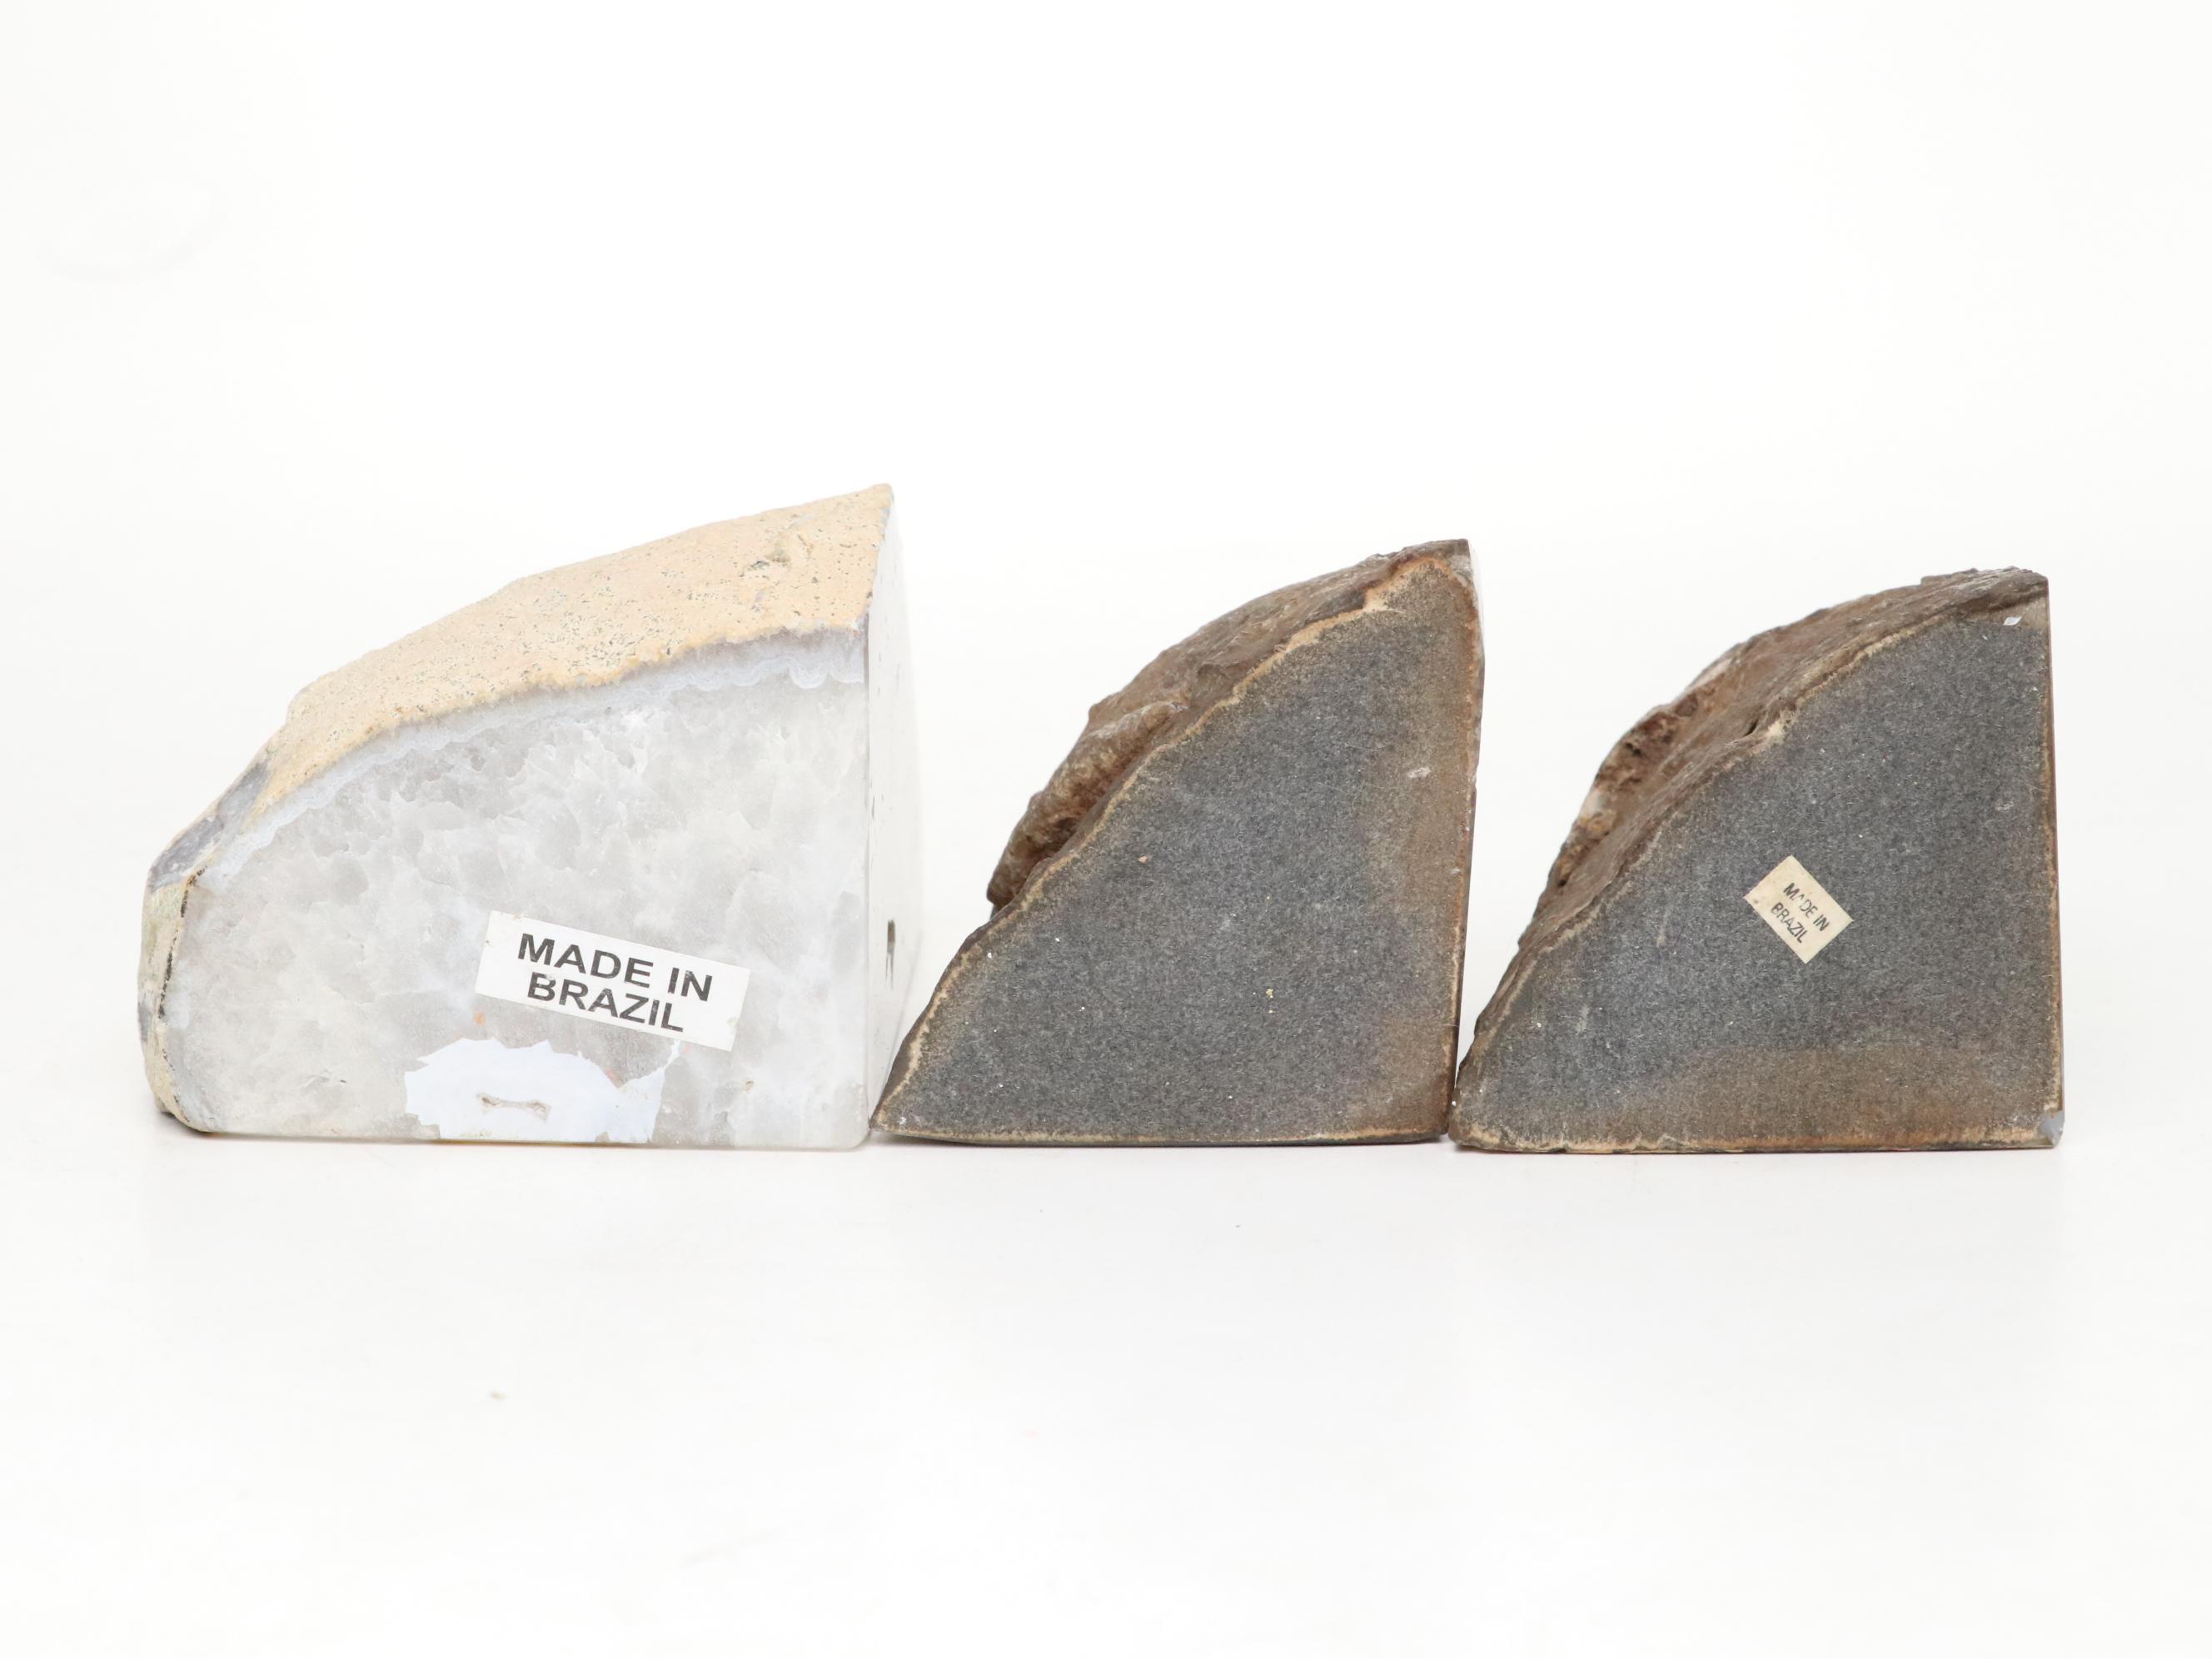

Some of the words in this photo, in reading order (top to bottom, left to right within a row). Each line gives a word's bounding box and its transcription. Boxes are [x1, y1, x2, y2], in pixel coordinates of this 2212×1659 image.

[1771, 901, 1808, 944] BRAZIL
[1813, 914, 1831, 932] IN
[517, 933, 654, 989] MADE
[668, 967, 713, 1002] IN
[527, 971, 684, 1033] BRAZIL
